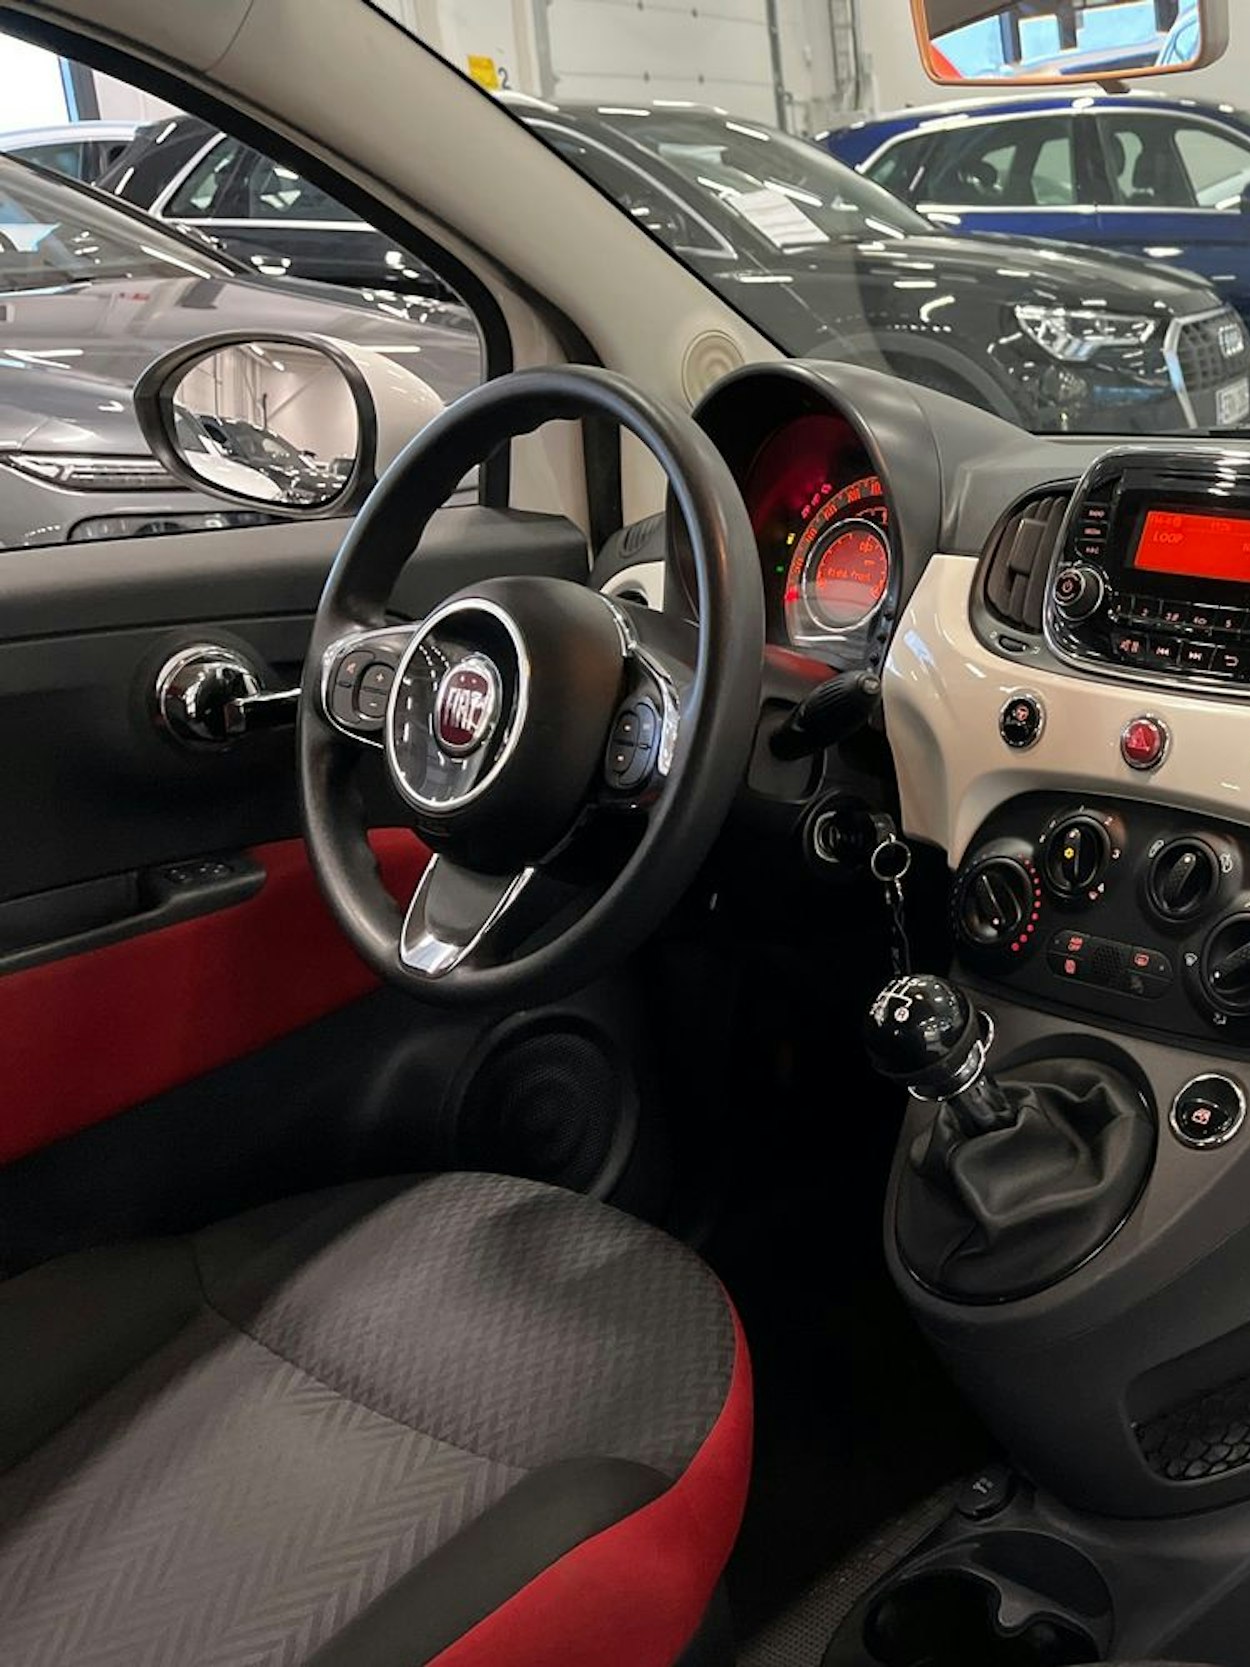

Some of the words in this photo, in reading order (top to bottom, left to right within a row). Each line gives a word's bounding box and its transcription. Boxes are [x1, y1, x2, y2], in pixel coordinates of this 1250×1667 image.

[498, 66, 512, 89] 2
[1153, 531, 1185, 545] LOOP
[443, 687, 485, 733] FIAT
[1112, 848, 1121, 860] 3
